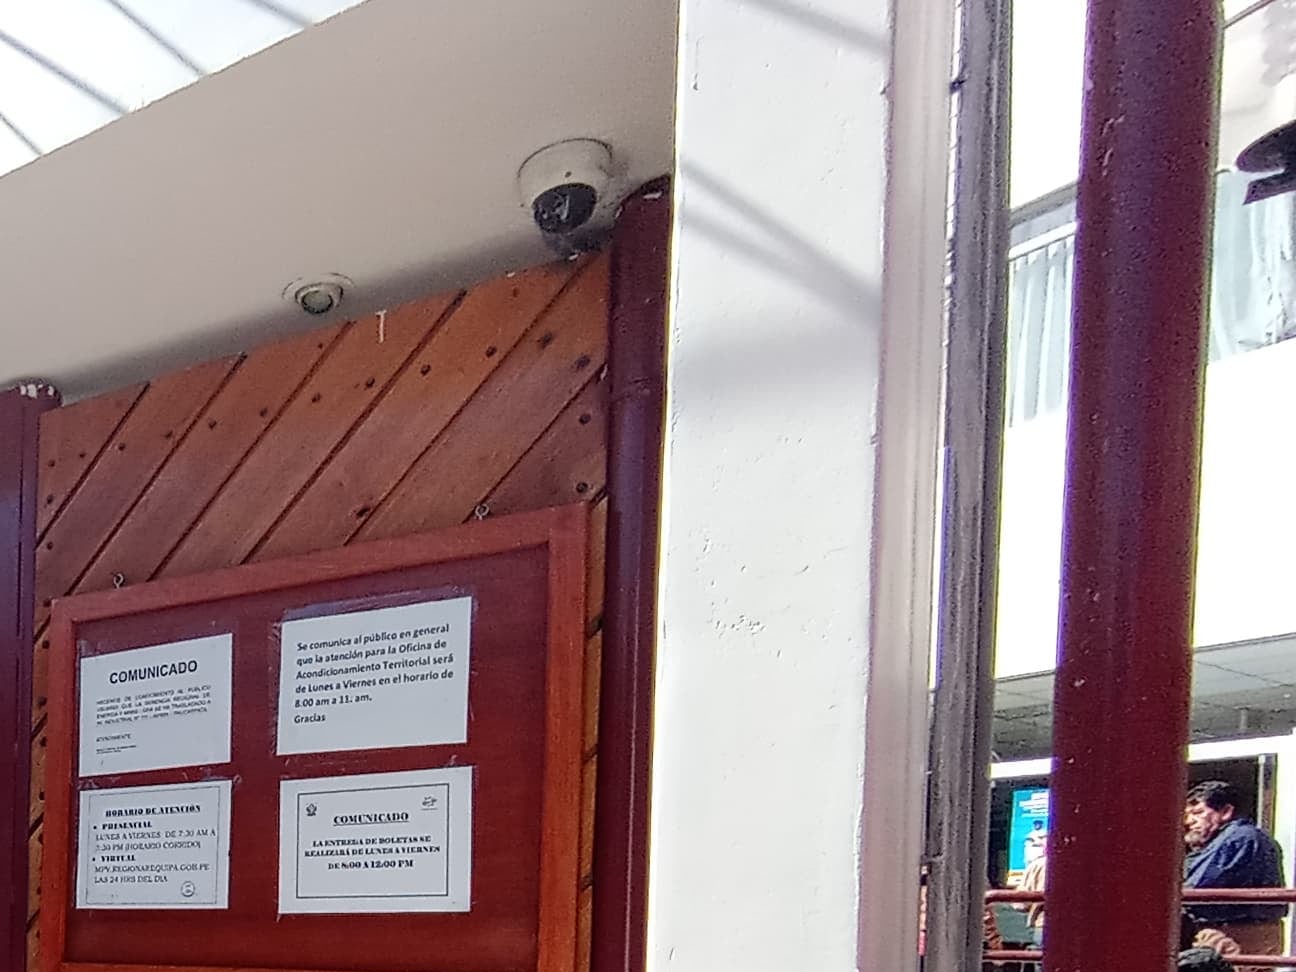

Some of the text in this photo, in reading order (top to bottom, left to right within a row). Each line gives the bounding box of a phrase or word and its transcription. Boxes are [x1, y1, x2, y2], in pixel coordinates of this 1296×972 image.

[297, 624, 449, 651] Se comunica al público en general
[296, 639, 447, 667] que la atención para la Oficina de
[296, 653, 453, 679] Acondicionamiento Territorial será
[109, 660, 198, 684] COMUNICADO
[295, 685, 306, 694] de
[308, 683, 334, 693] Lunes
[342, 678, 377, 689] Viernes
[378, 677, 391, 685] en
[392, 674, 401, 684] el
[403, 670, 439, 682] horario
[441, 669, 453, 679] de
[315, 698, 329, 706] am
[331, 697, 337, 705] a
[294, 713, 326, 724] Gracias
[105, 808, 144, 817] HORARIO
[146, 807, 157, 815] DE
[333, 812, 409, 824] COMUNICADO
[102, 821, 153, 830] PRESENCIAL
[312, 840, 323, 848] LA
[352, 848, 364, 856] DE
[365, 847, 393, 855] LUNES
[395, 846, 400, 854] A
[401, 845, 441, 854] VIERNES
[101, 854, 136, 862] VIRTUAL
[328, 862, 340, 870] DE
[363, 860, 370, 869] A
[398, 859, 414, 868] PM
